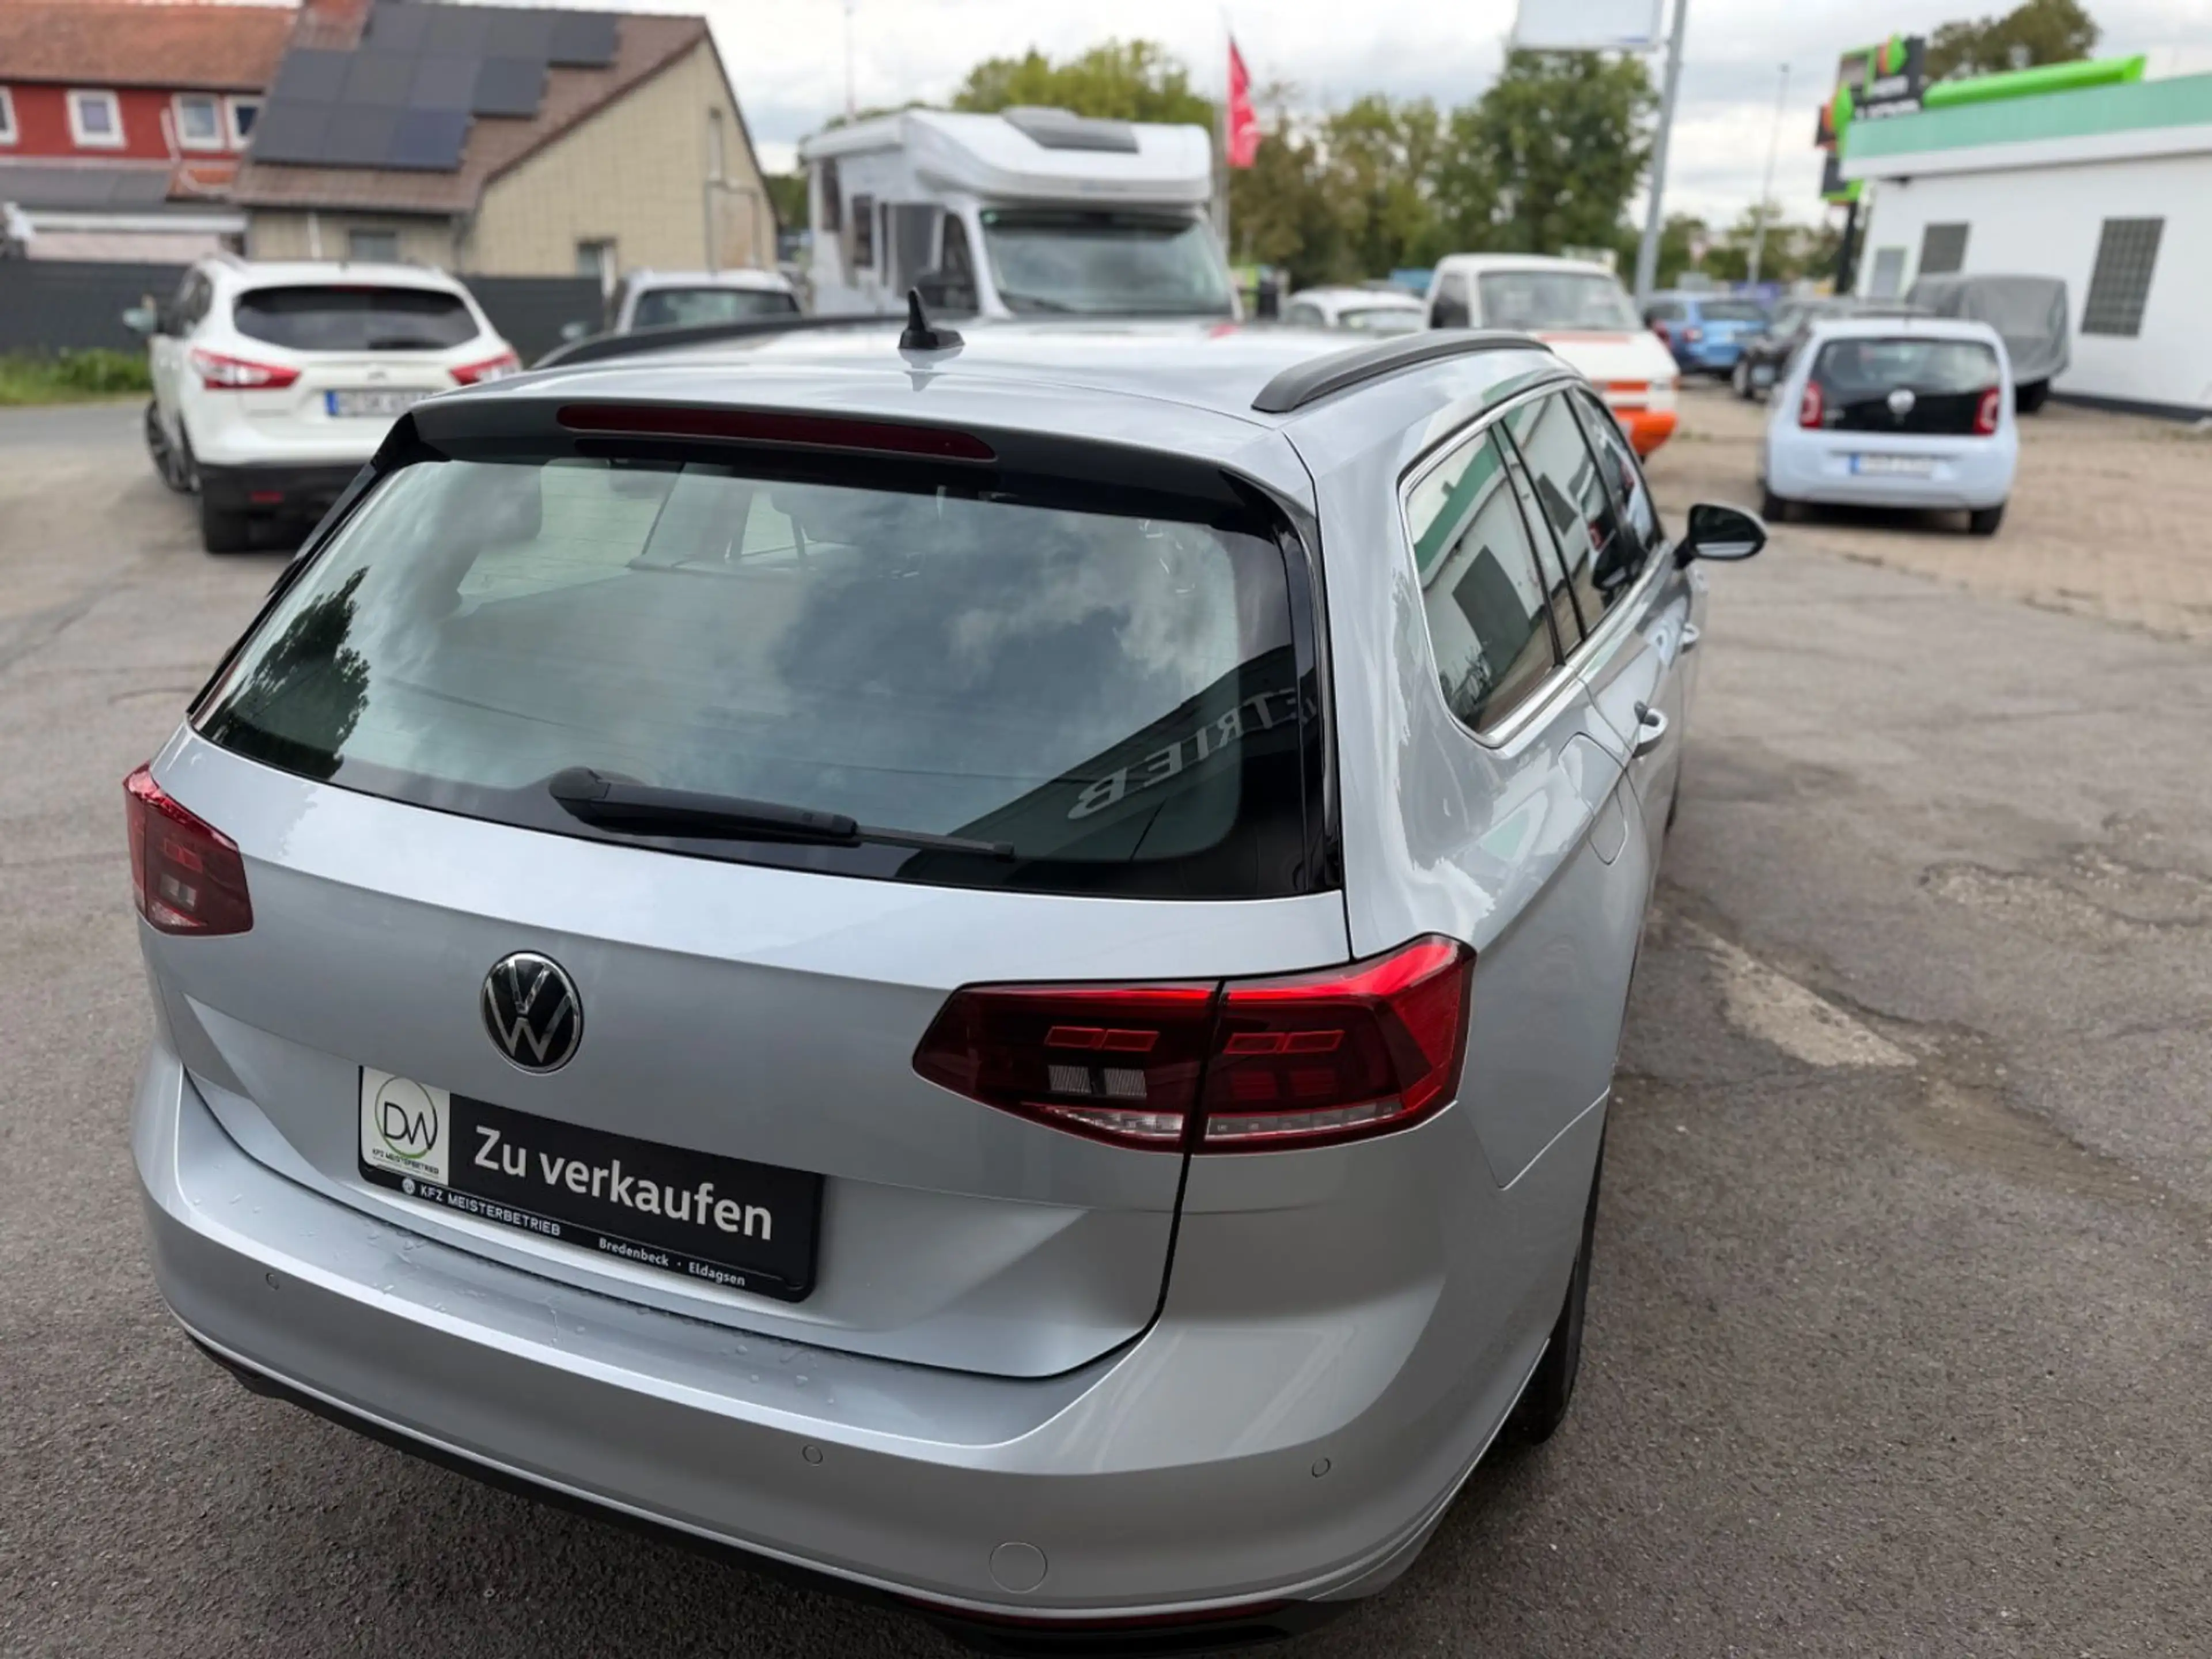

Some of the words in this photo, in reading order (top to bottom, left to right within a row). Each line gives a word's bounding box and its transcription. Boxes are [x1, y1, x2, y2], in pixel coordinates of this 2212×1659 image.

[474, 1125, 527, 1177] Zu
[539, 1152, 772, 1240] verkaufen
[420, 1184, 443, 1202] KFZ
[447, 1193, 561, 1236] MEISTERBETRIEB
[599, 1237, 669, 1267] Bredenbeck
[688, 1261, 745, 1286] Eldagsen
